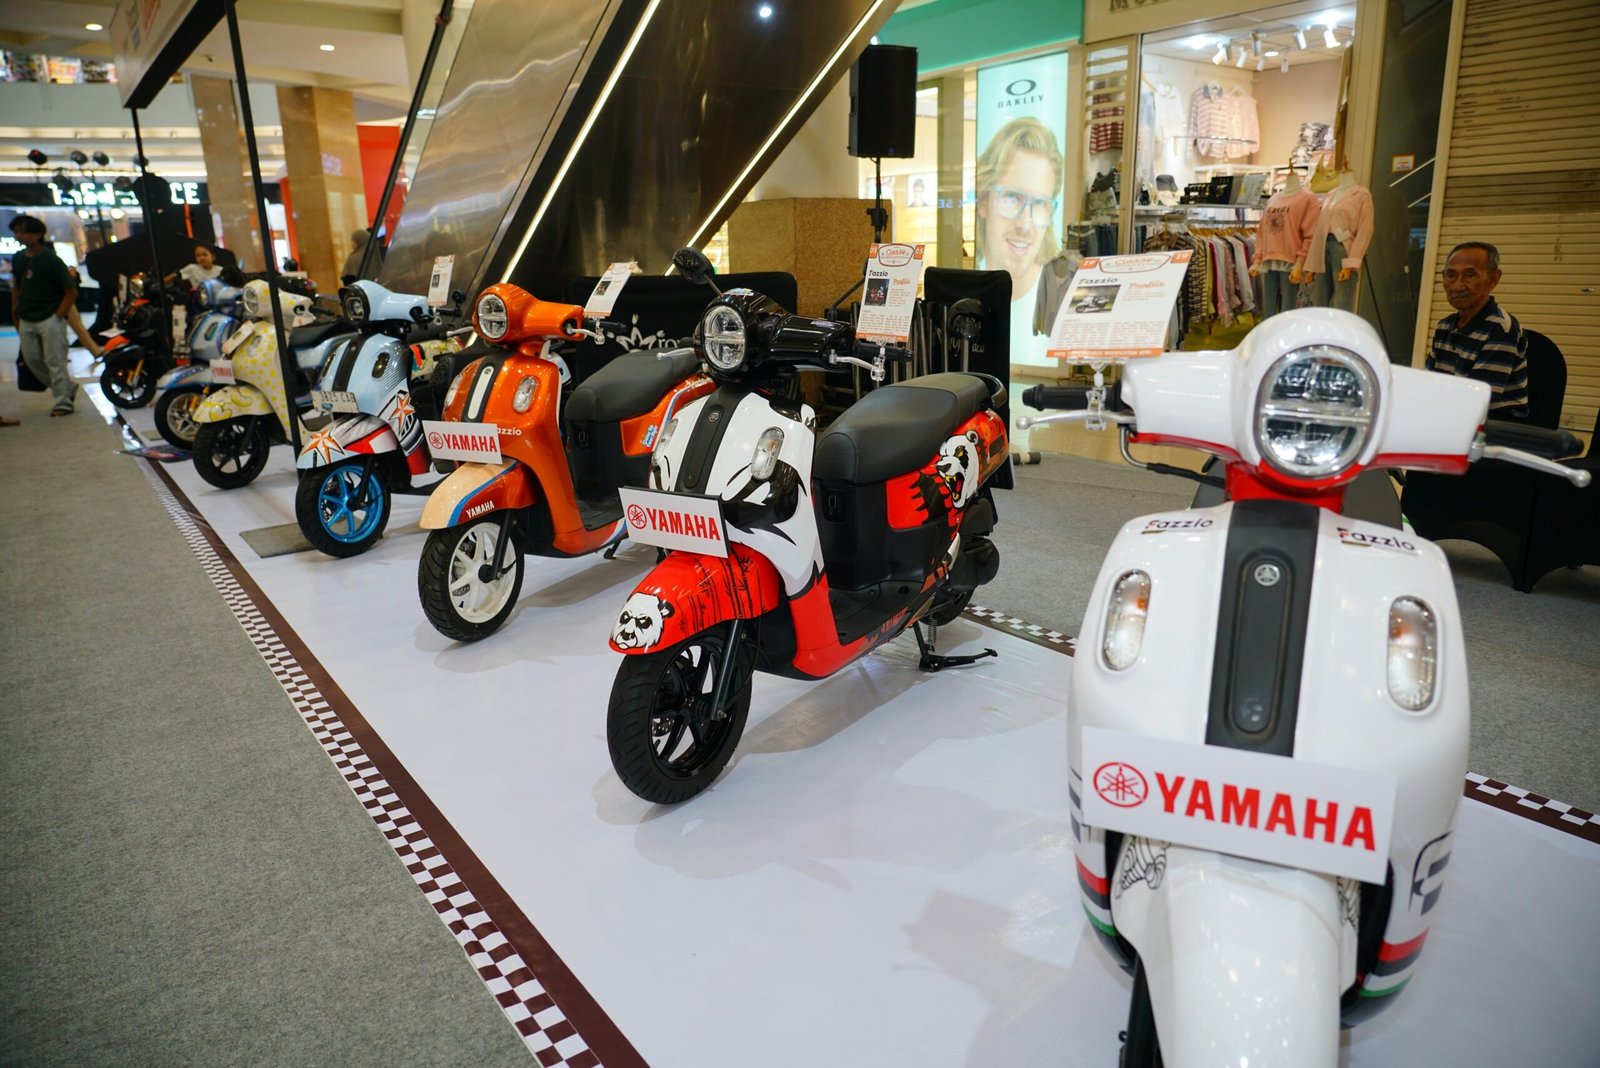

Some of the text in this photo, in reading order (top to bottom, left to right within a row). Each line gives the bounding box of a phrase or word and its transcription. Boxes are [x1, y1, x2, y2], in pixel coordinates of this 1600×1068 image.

[997, 95, 1044, 108] OAKLEY
[1078, 277, 1119, 285] Fazzio
[496, 427, 522, 436] azzio
[442, 433, 498, 453] YAMAHA
[465, 500, 495, 519] YAMAHA
[646, 507, 721, 541] YAMAHA
[1145, 518, 1213, 530] Fazzio
[1337, 526, 1415, 551] Fazzio
[1154, 771, 1376, 852] YAMAHA
